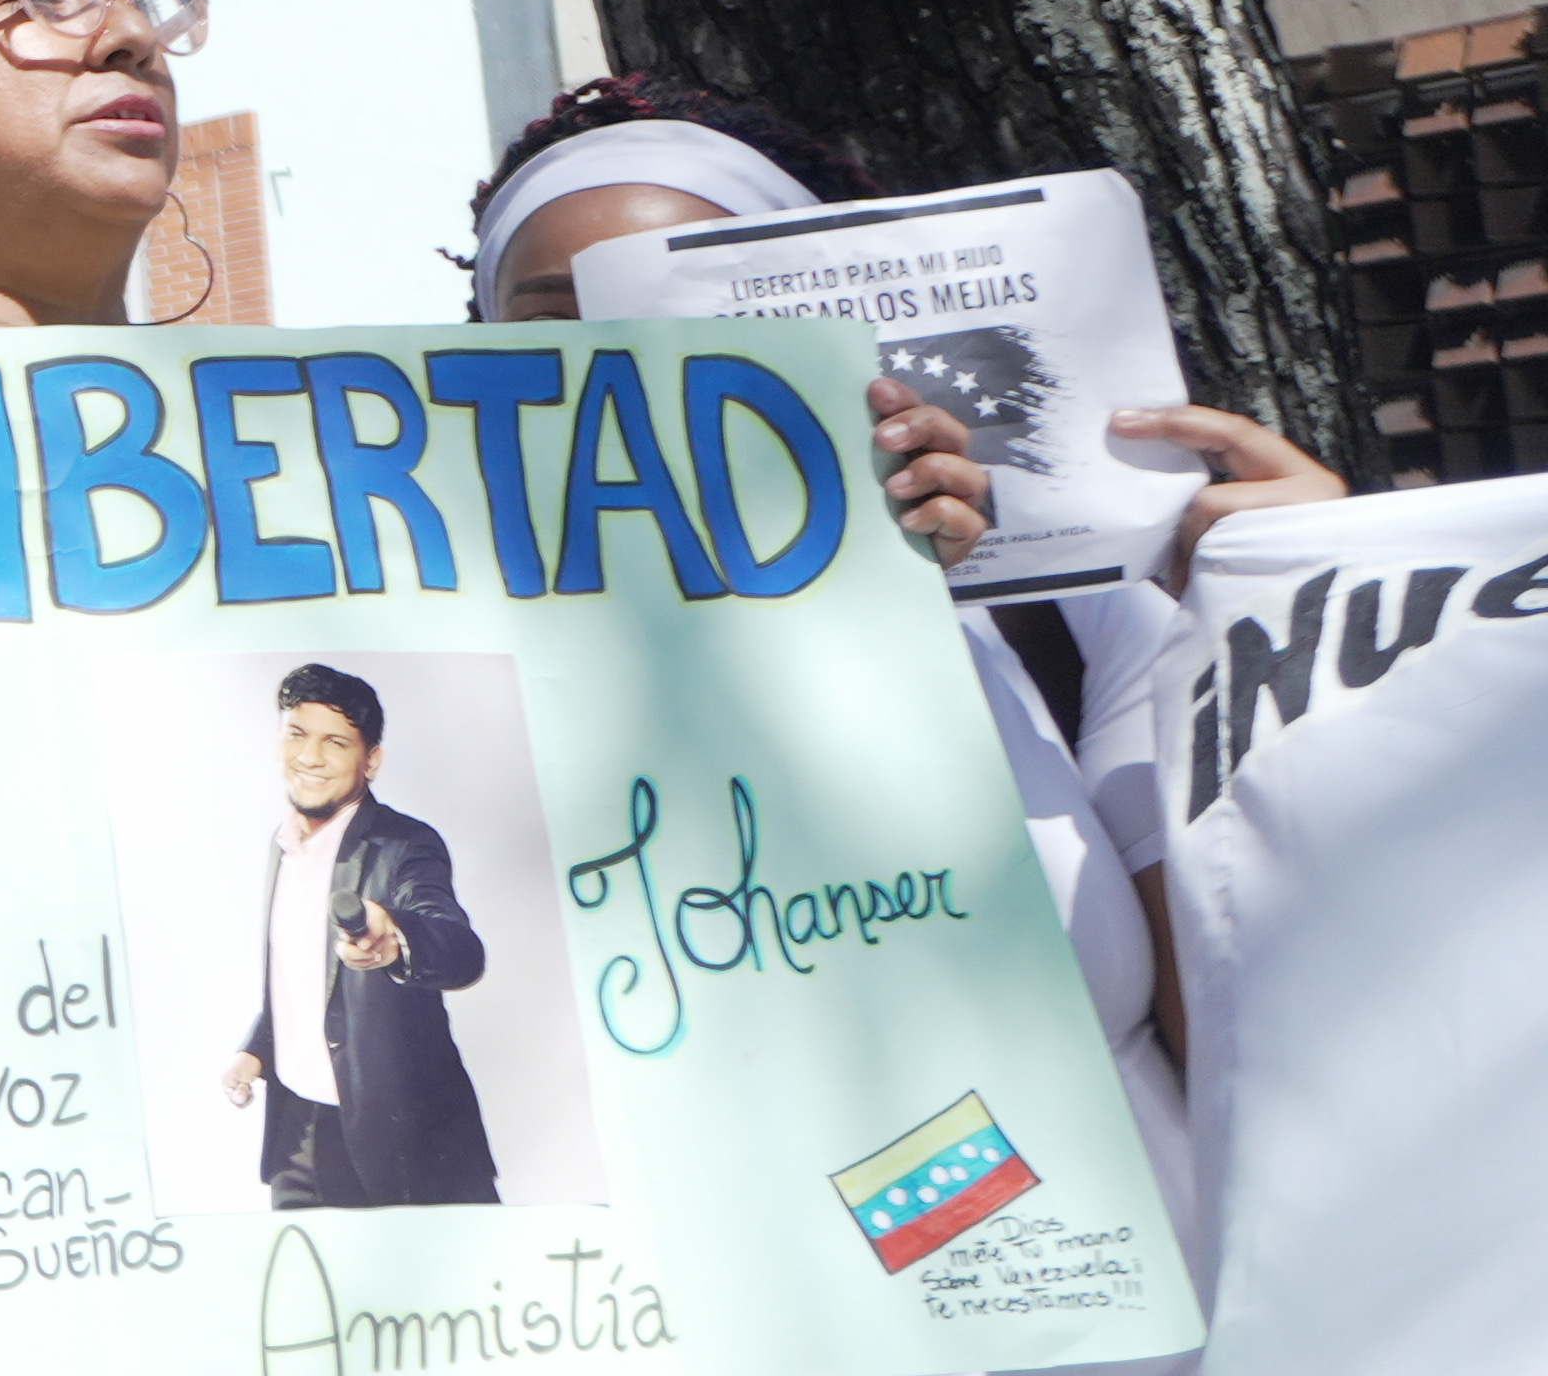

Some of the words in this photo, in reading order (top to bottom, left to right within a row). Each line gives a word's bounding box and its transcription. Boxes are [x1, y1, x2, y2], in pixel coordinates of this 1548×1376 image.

[731, 268, 837, 301] LIBERTAD
[846, 258, 912, 286] PARA
[917, 251, 947, 275] MI
[953, 244, 1004, 271] HIJO
[930, 272, 1040, 314] MEJIAS
[17, 935, 118, 1036] del
[987, 1215, 1064, 1242] Dios
[1055, 1227, 1132, 1248] mano
